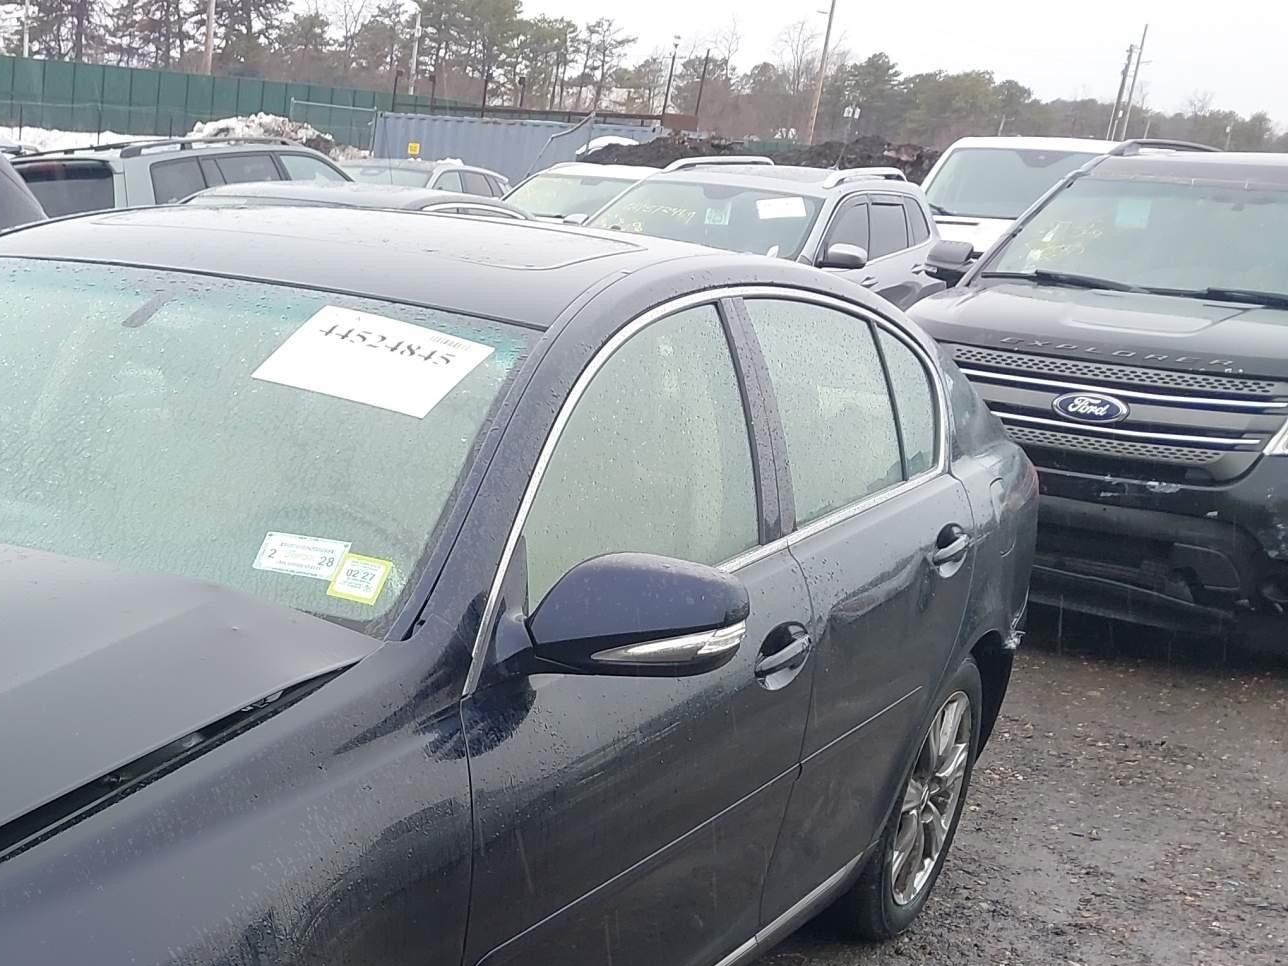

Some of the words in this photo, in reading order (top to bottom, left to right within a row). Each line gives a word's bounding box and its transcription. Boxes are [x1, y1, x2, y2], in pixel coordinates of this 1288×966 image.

[319, 323, 457, 366] 44524845
[1068, 396, 1110, 417] Ford
[268, 548, 278, 560] 2
[317, 556, 335, 568] 28
